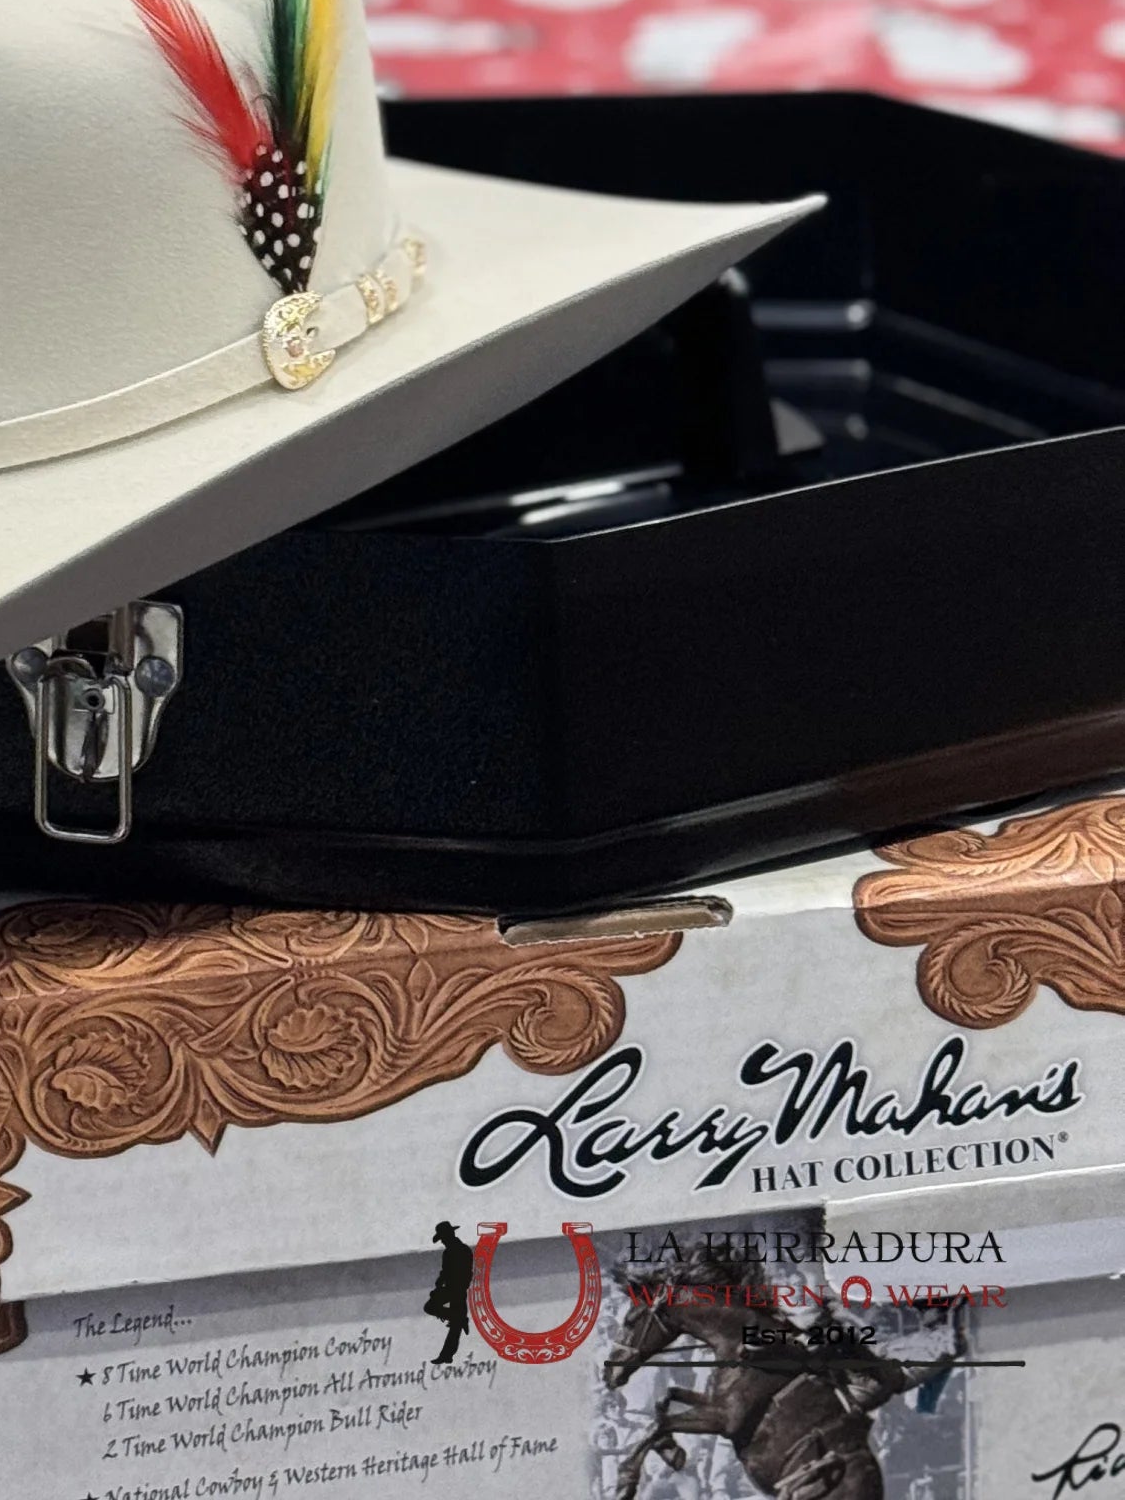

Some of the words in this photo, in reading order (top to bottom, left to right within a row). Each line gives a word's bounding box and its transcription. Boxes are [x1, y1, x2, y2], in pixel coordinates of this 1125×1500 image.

[459, 1045, 768, 1198] Larry
[739, 1036, 1081, 1145] Mahan's
[751, 1160, 823, 1194] HAT
[74, 1312, 107, 1338] The
[101, 1365, 115, 1386] 8
[116, 1360, 161, 1384] Time
[165, 1349, 223, 1379] World
[225, 1340, 321, 1380] Champion
[324, 1327, 393, 1366] Cowboy
[102, 1401, 113, 1423] 6
[116, 1397, 161, 1421] Time
[165, 1386, 224, 1416] World
[225, 1377, 321, 1417] Champion
[323, 1371, 355, 1395] All
[358, 1360, 428, 1391] Around
[430, 1351, 498, 1390] Cowboy
[101, 1438, 118, 1461] 2
[121, 1433, 166, 1458] Time
[170, 1423, 228, 1453] World
[230, 1413, 325, 1452] Champion
[329, 1405, 372, 1432] Bull
[376, 1400, 424, 1430] Rider
[104, 1477, 191, 1500] National
[194, 1467, 264, 1500] Cowboy
[282, 1465, 358, 1485] Western
[361, 1451, 439, 1484] Heritage
[441, 1440, 485, 1467] Hall
[488, 1434, 510, 1473] of
[508, 1435, 558, 1457] Fame
